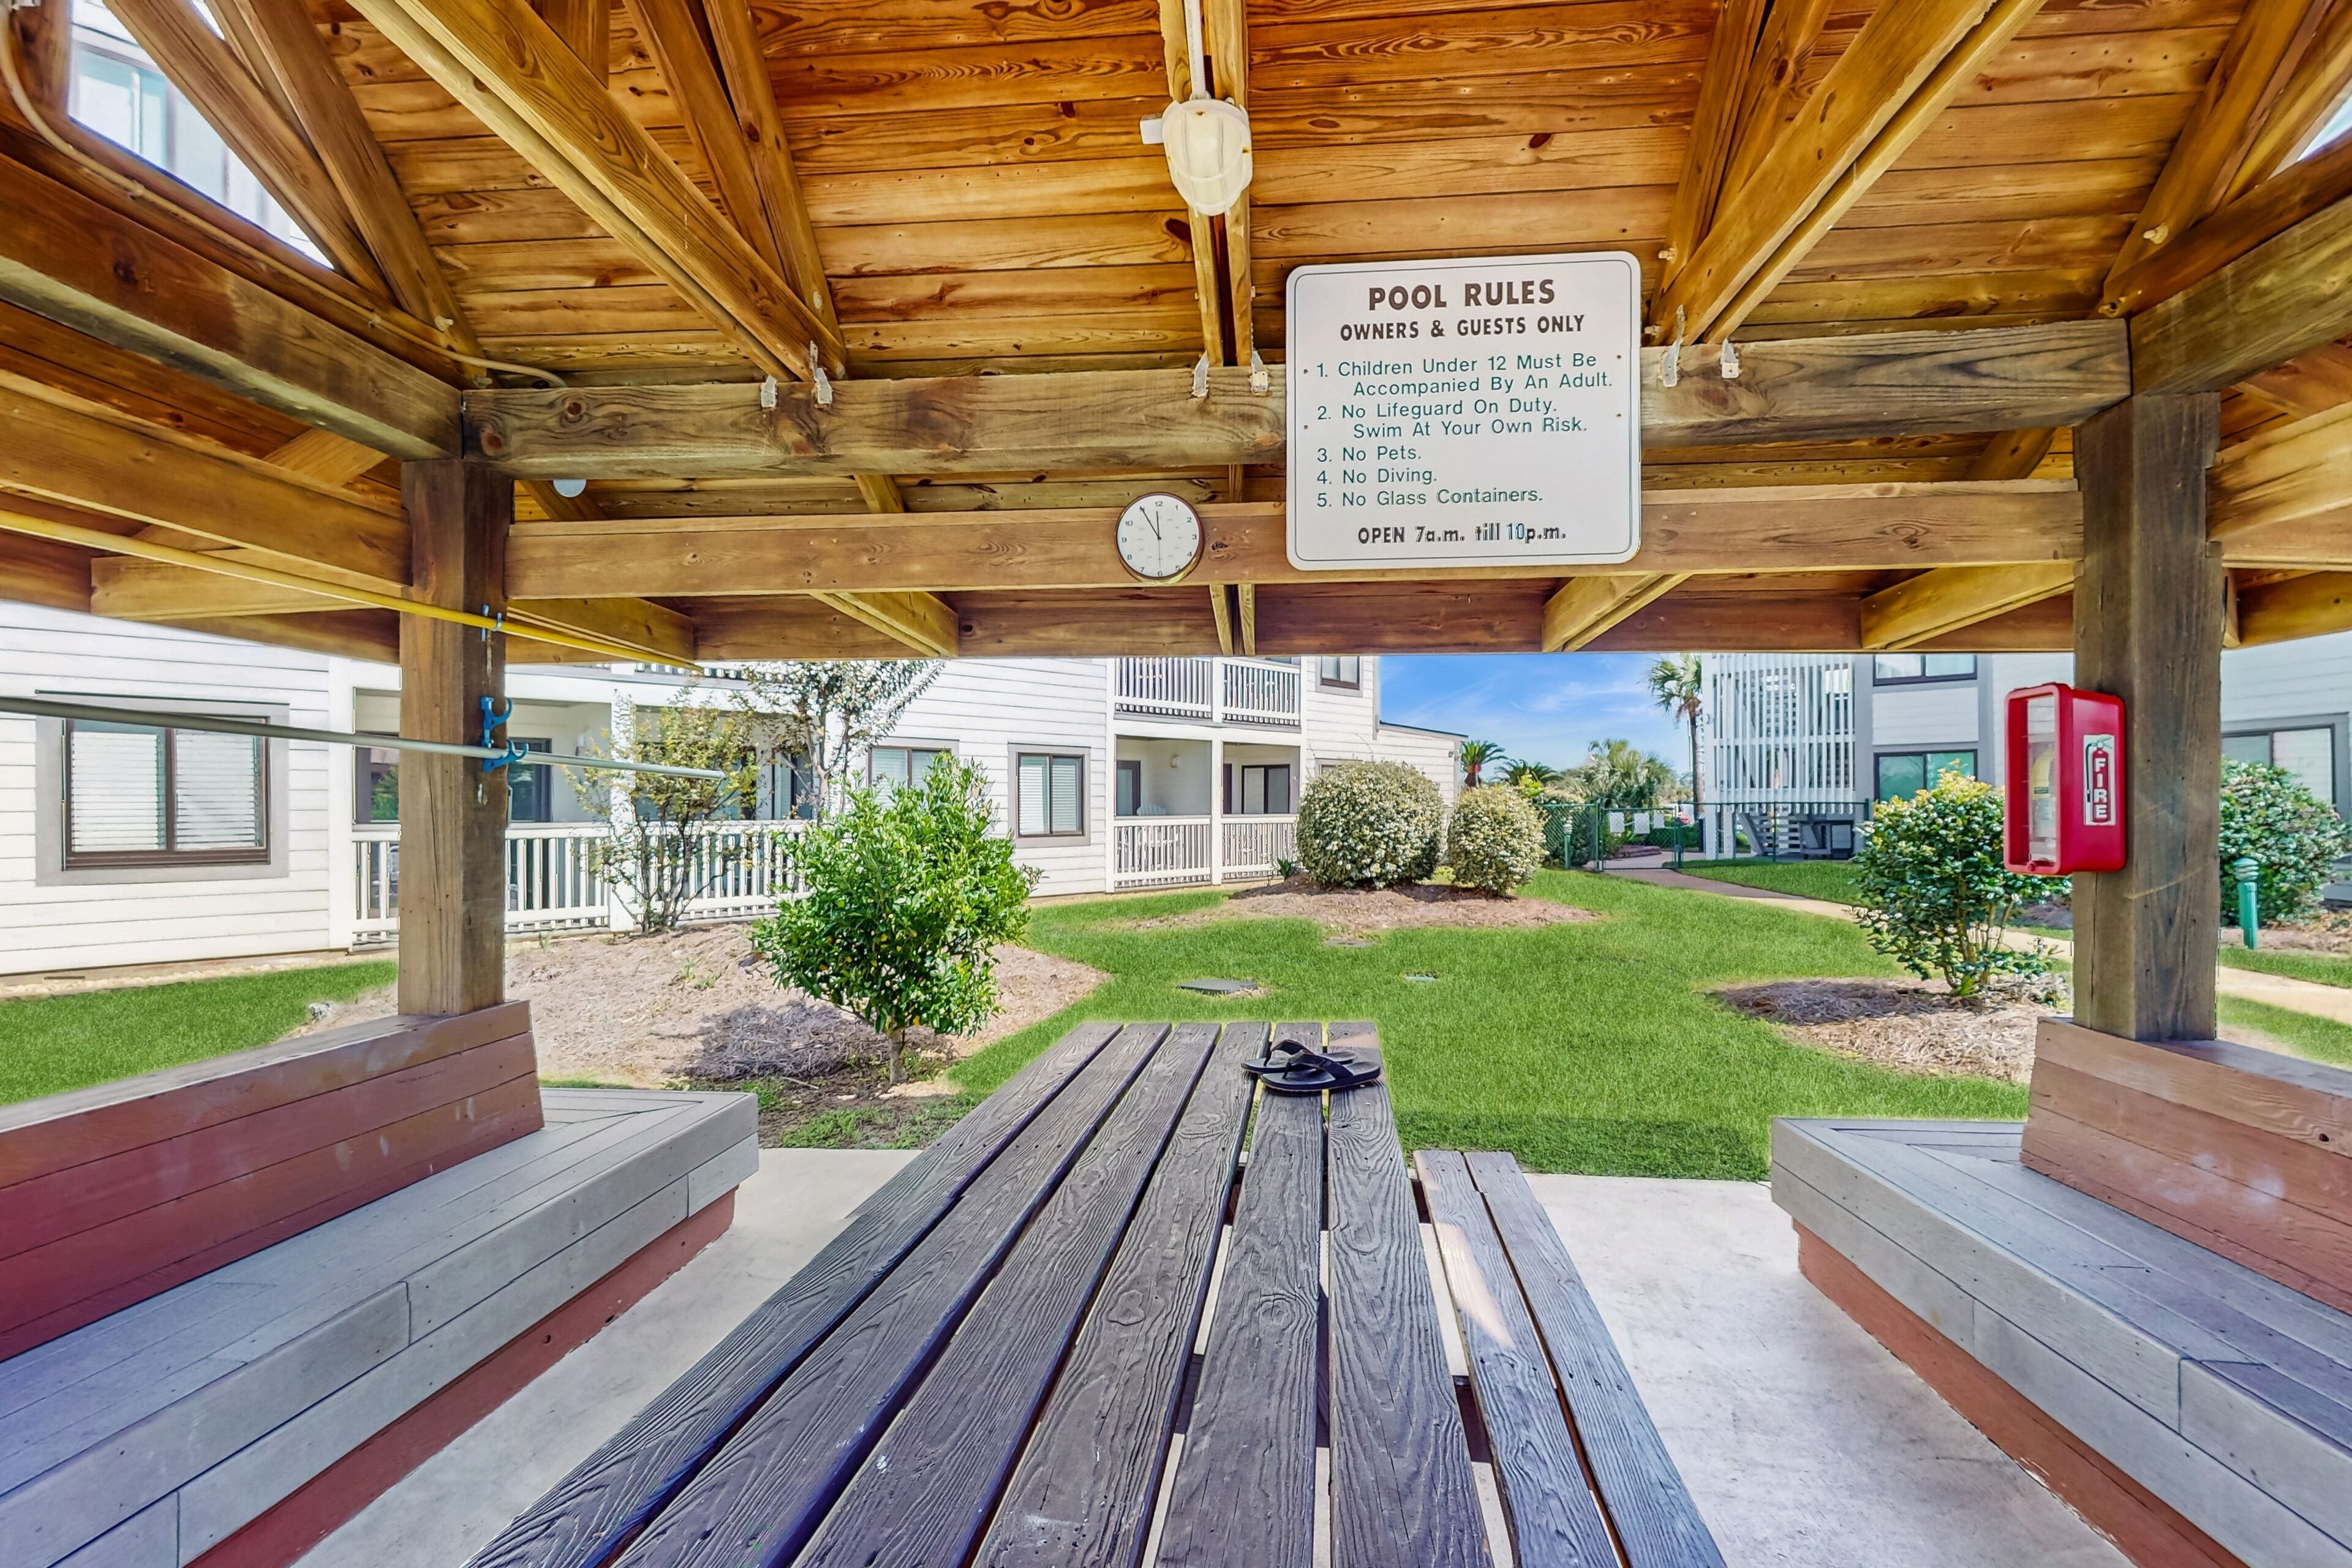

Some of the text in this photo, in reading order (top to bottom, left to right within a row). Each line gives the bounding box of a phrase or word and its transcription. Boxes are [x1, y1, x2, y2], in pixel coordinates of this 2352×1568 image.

[1368, 279, 1555, 311] POOL RULES
[1340, 314, 1585, 342] OWNERS & GUESTS ONLY
[1316, 352, 1597, 378] 1. Children Under 12 Must Be
[1353, 371, 1612, 398] Accompanied By An Adult.
[1317, 397, 1557, 420] 2. No Lifeguard On Duty.
[1353, 416, 1587, 439] Swim At Your Own Risk.
[1317, 445, 1422, 462] 3. No Pets.
[1316, 467, 1437, 485] 4. No Diving.
[1317, 487, 1544, 508] 5. No Glass Containers.
[1357, 522, 1567, 545] OPEN 7a.m. till 10p.m.
[2094, 758, 2108, 819] FIRE
